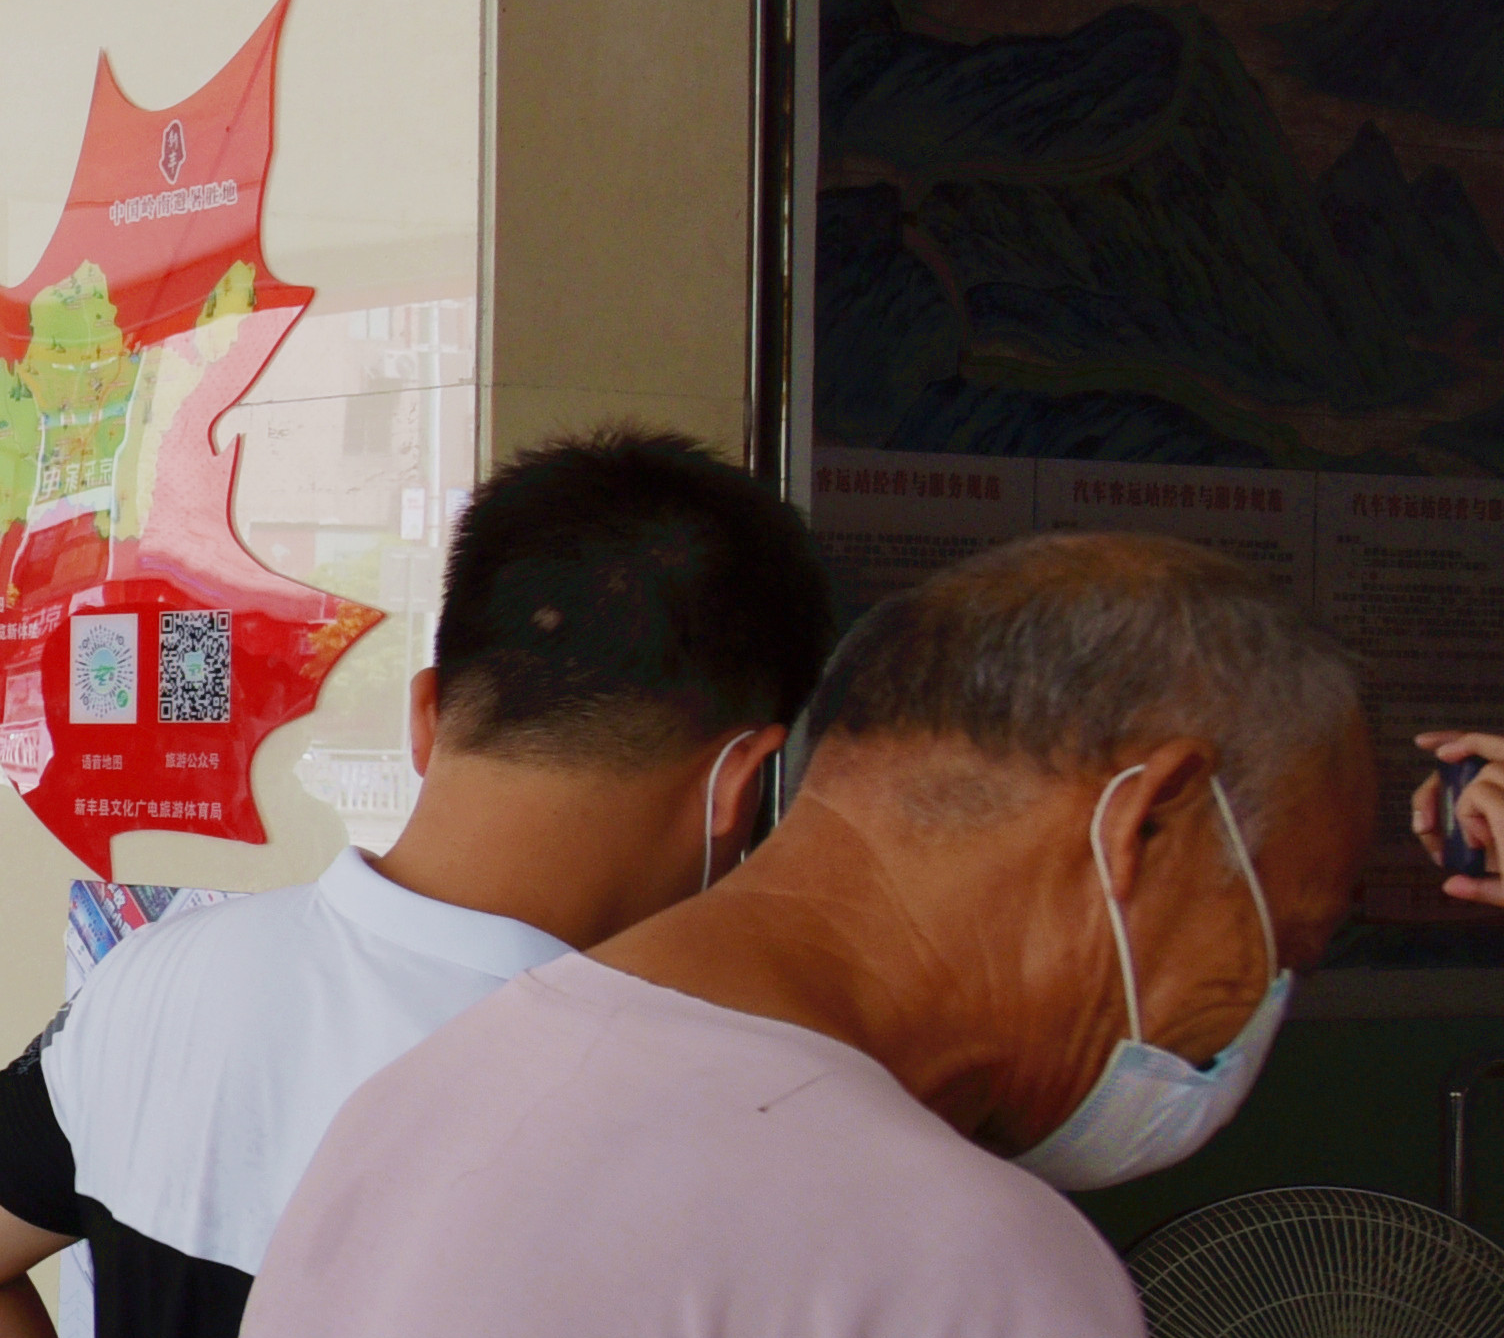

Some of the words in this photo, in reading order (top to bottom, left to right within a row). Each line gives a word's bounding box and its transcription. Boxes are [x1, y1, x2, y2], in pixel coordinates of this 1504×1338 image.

[81, 754, 123, 771] 语音地图
[165, 752, 220, 770] 旅游公众号
[74, 798, 223, 821] 新丰县文化广电旅游体育局
